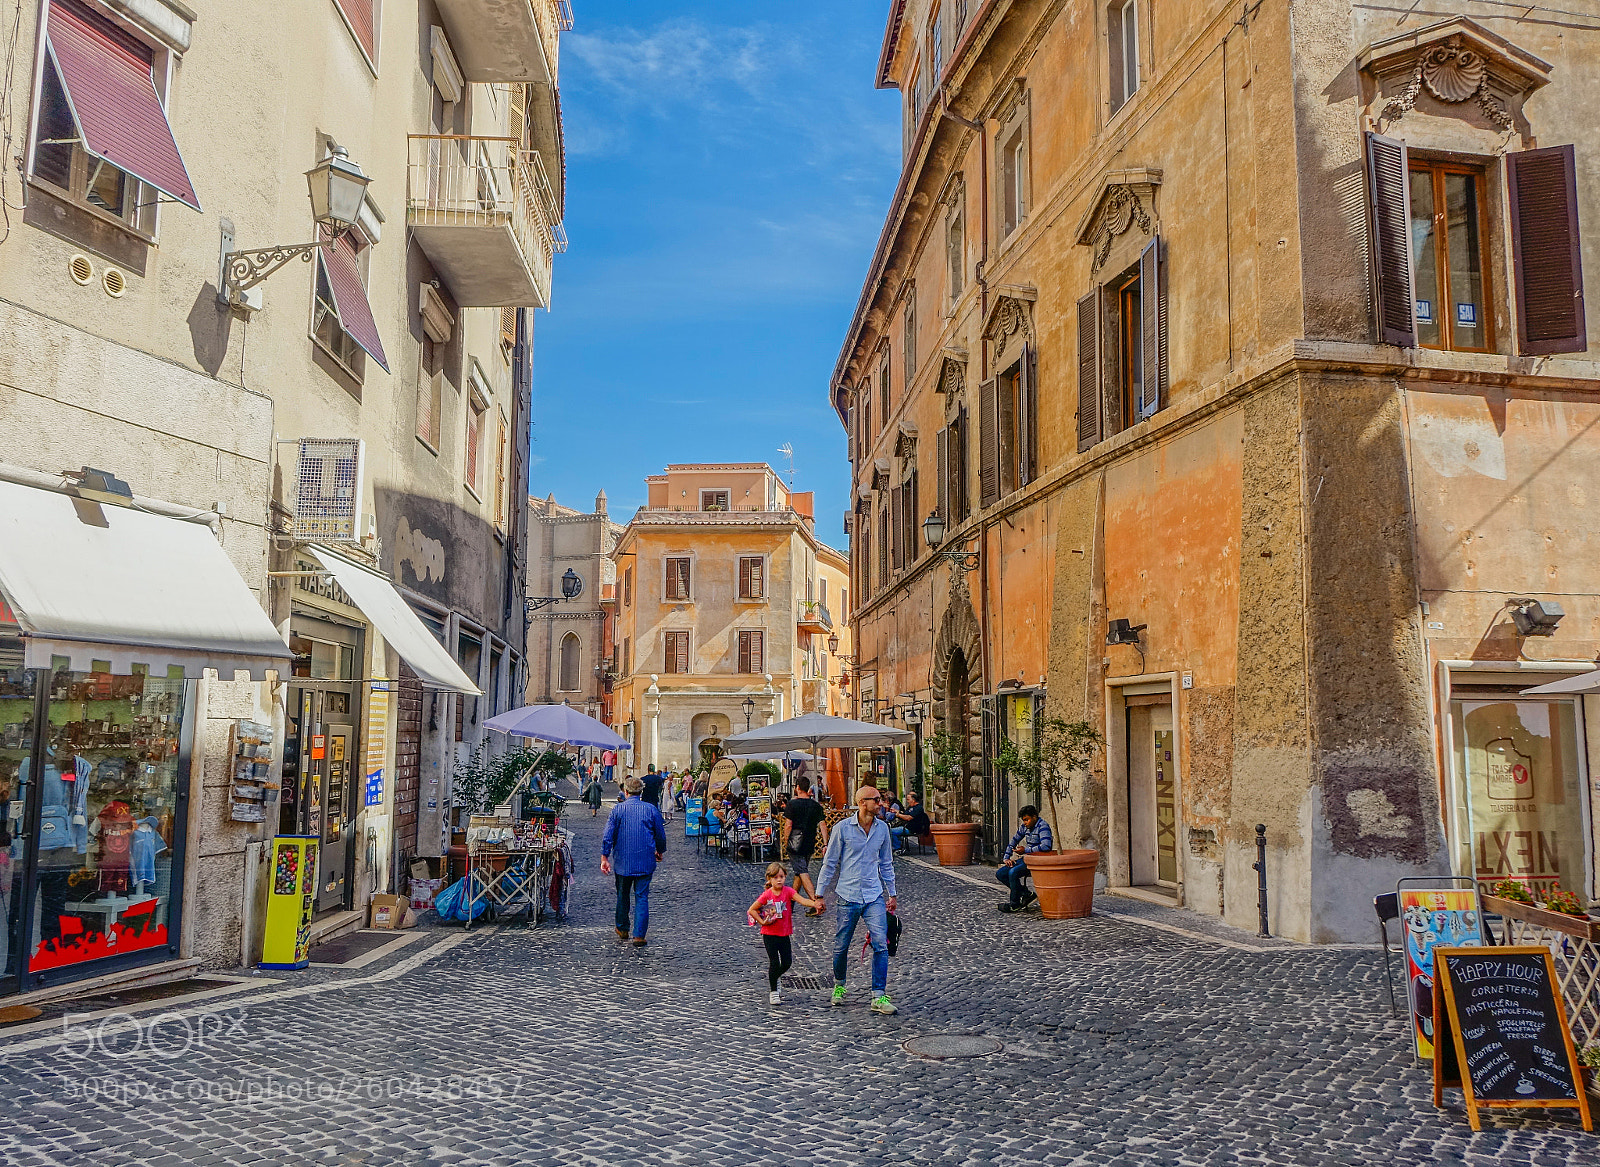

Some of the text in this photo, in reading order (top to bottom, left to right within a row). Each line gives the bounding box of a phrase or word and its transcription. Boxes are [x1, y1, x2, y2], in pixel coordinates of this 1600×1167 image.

[1157, 780, 1176, 858] NEXT
[1455, 961, 1544, 983] HAPPY HOUR
[1471, 984, 1539, 998] CORNETTERIA
[1465, 999, 1519, 1016] PASTICCERIA
[1491, 1008, 1545, 1018] NAPOLETANA
[1497, 1020, 1547, 1029] SFOGLIATELLE
[1533, 1045, 1556, 1059] BIRRA
[1472, 1051, 1511, 1083] SANDWICHES
[1528, 1067, 1570, 1090] SPREMUTE
